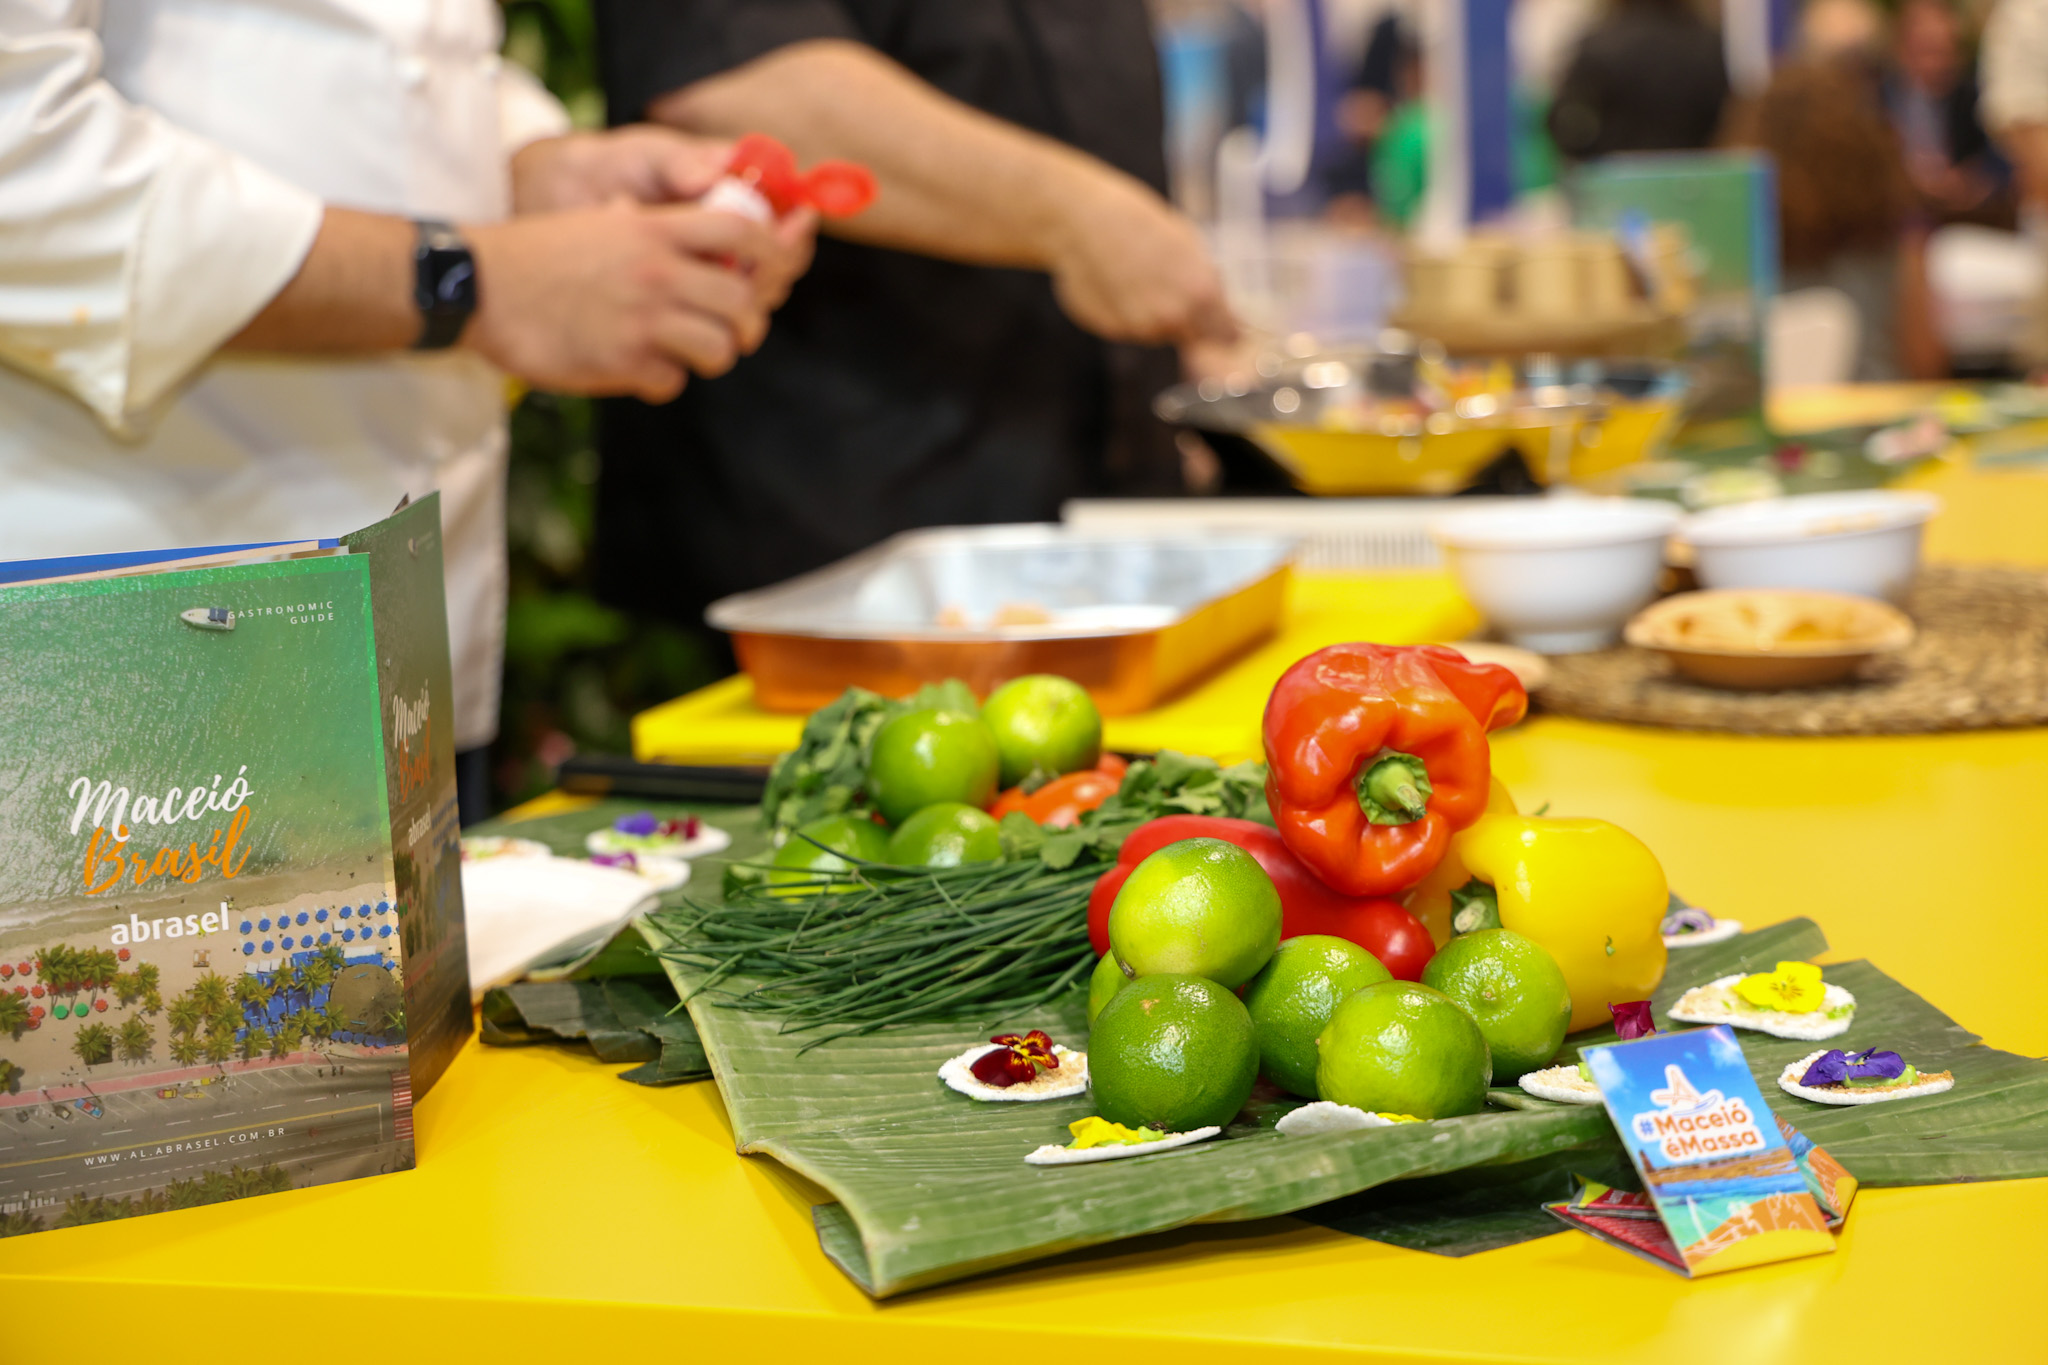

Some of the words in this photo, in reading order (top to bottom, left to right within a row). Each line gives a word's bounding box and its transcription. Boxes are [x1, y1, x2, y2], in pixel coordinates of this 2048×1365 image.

[227, 601, 333, 620] GASTRONOMIC
[290, 613, 334, 625] GUIDE
[68, 764, 255, 843] Maceió
[408, 803, 431, 846] abrasel
[83, 804, 252, 895] Brasil
[111, 901, 230, 945] abrasel
[1639, 1103, 1748, 1136] #Maceió
[84, 1127, 285, 1166] WWW.AL.ABRASEL.COM.BR
[1666, 1130, 1758, 1158] éMassa
